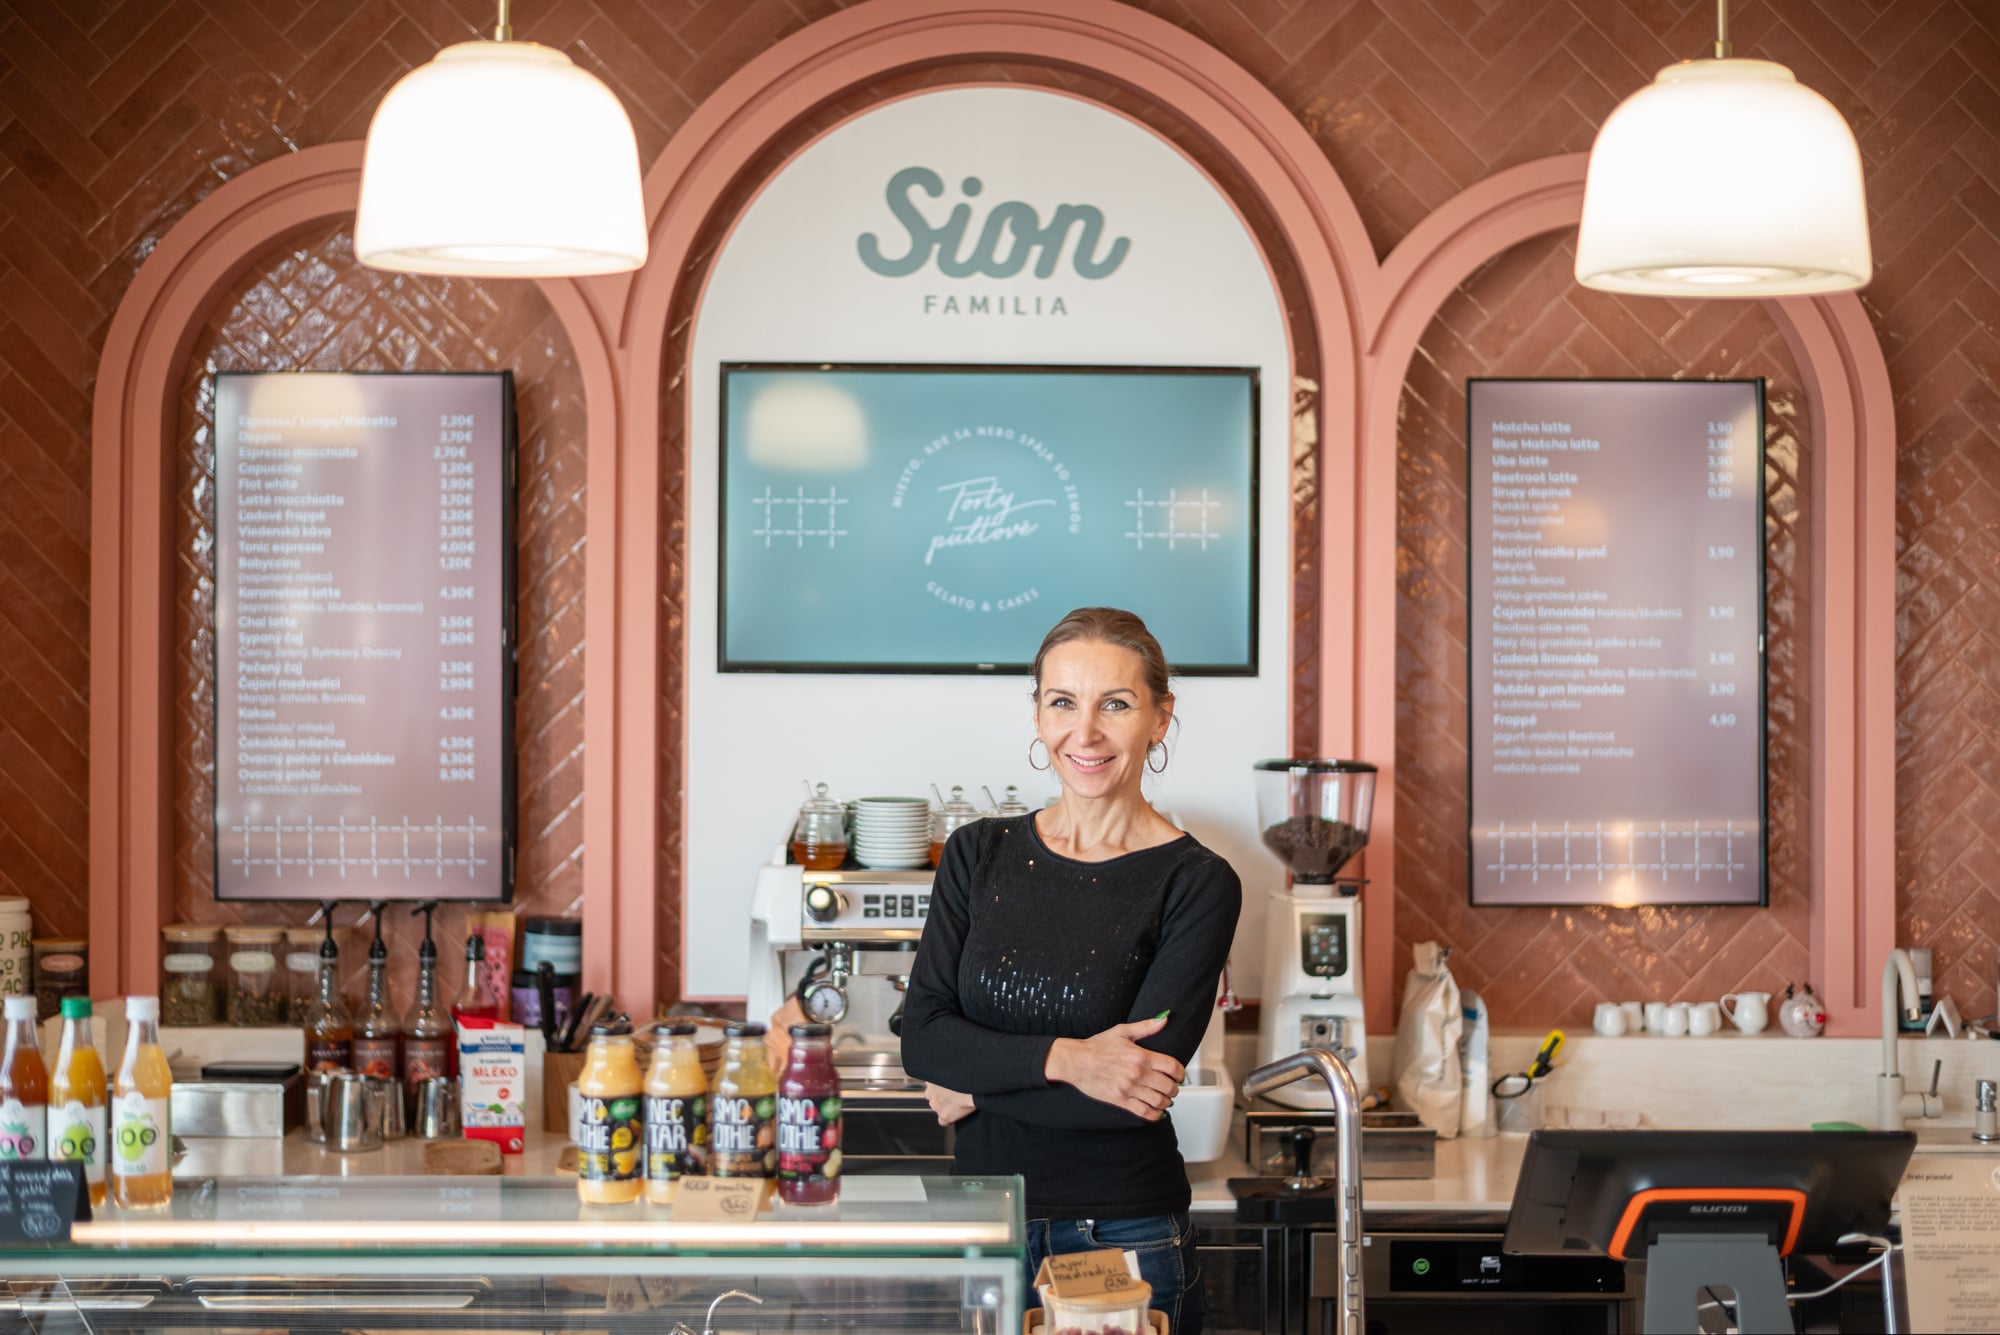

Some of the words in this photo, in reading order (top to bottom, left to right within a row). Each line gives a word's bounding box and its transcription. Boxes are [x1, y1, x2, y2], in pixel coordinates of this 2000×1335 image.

[857, 166, 1131, 280] Sion
[923, 295, 1068, 315] FAMILIA
[953, 428, 972, 440] SA
[976, 425, 1016, 440] NEBO
[1053, 463, 1070, 481] SO
[936, 476, 1057, 524] Torty
[926, 580, 975, 610] GELATO
[981, 600, 991, 612] &
[997, 587, 1039, 610] CAKES
[650, 1099, 684, 1124] NEC
[650, 1125, 687, 1149] TAR
